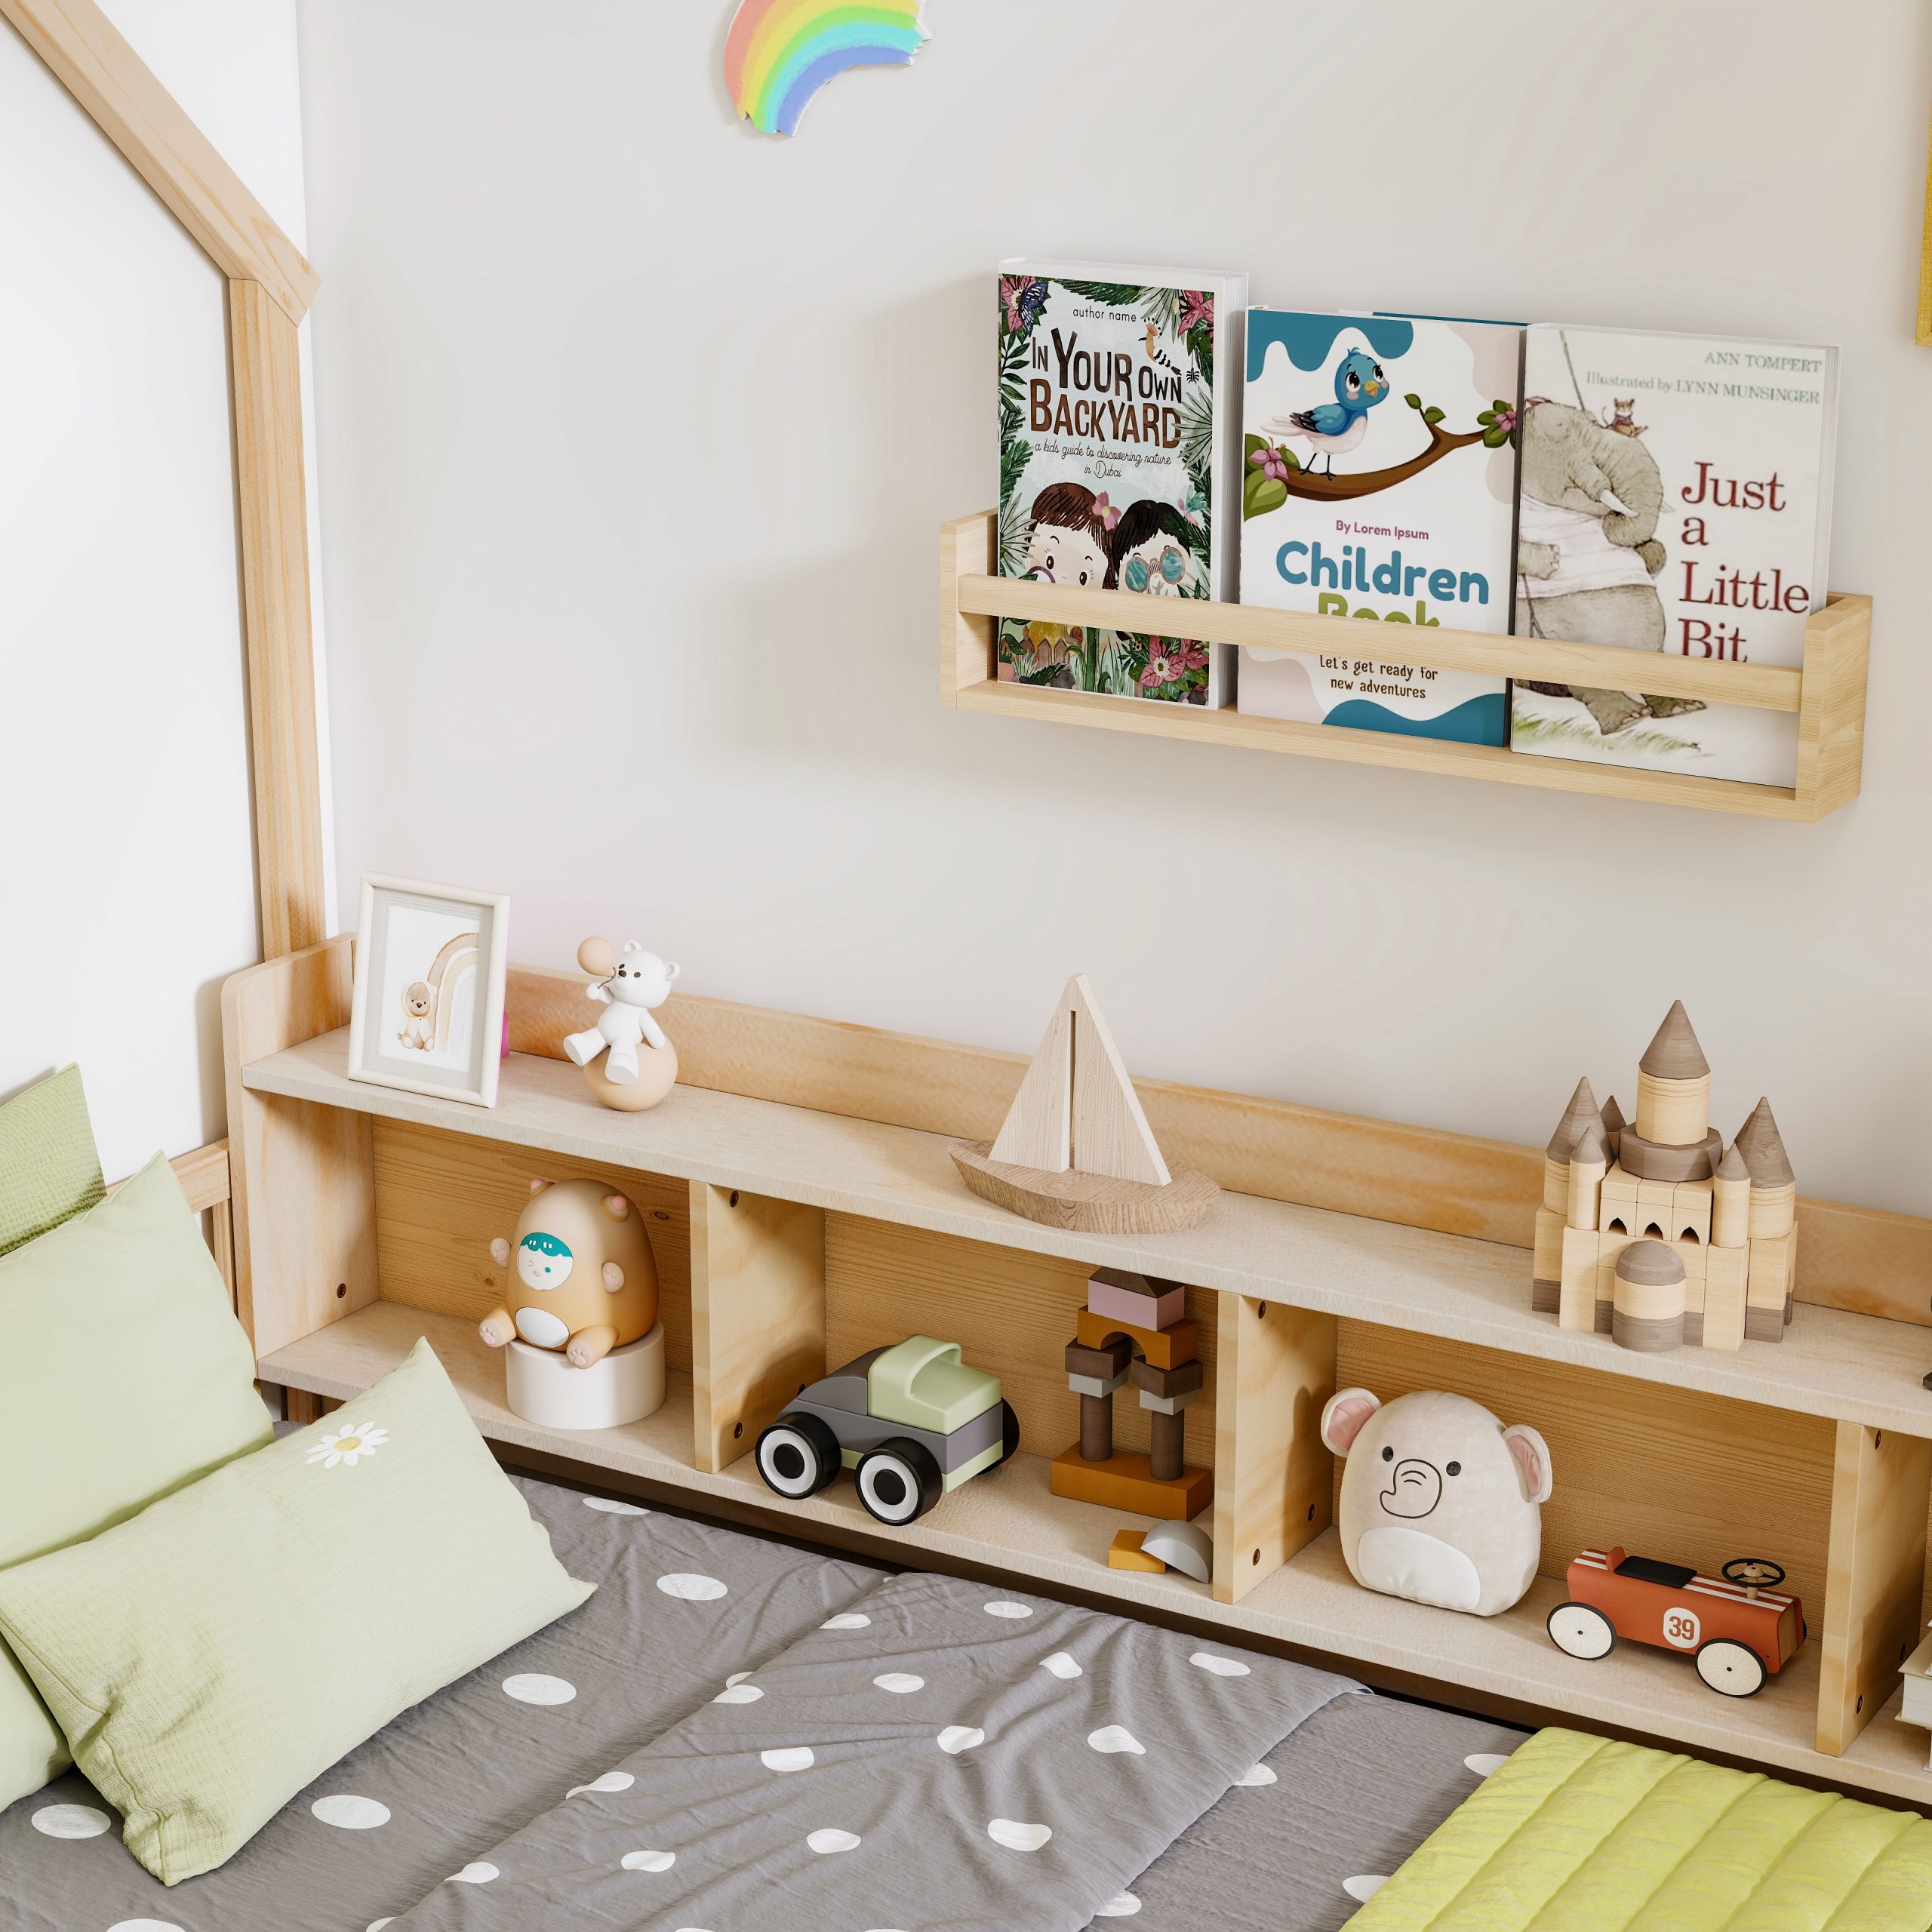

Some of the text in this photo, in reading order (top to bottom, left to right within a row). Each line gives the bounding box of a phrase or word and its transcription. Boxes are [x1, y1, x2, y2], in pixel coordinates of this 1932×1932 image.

[1072, 306, 1137, 322] author name
[1032, 328, 1182, 404] IN YOUR OWN
[1704, 352, 1823, 373] ANN TOMPERT
[1586, 371, 1820, 405] Illustrated by LYNN MUNSINGER
[1029, 378, 1182, 449] BACKYARD
[1035, 438, 1172, 467] a kids guide to discovering nature
[1084, 460, 1122, 478] in Dubai
[1681, 461, 1786, 512] Just
[1336, 519, 1429, 540] By Lorem Ipsum
[1681, 516, 1709, 546] a
[1275, 540, 1489, 605] Children
[1678, 561, 1810, 614] Little
[1678, 618, 1748, 663] Bit
[1353, 661, 1374, 676] get
[1380, 665, 1414, 681] ready
[1420, 666, 1438, 681] for
[1331, 678, 1426, 699] new adventures
[1669, 1616, 1695, 1641] 39
